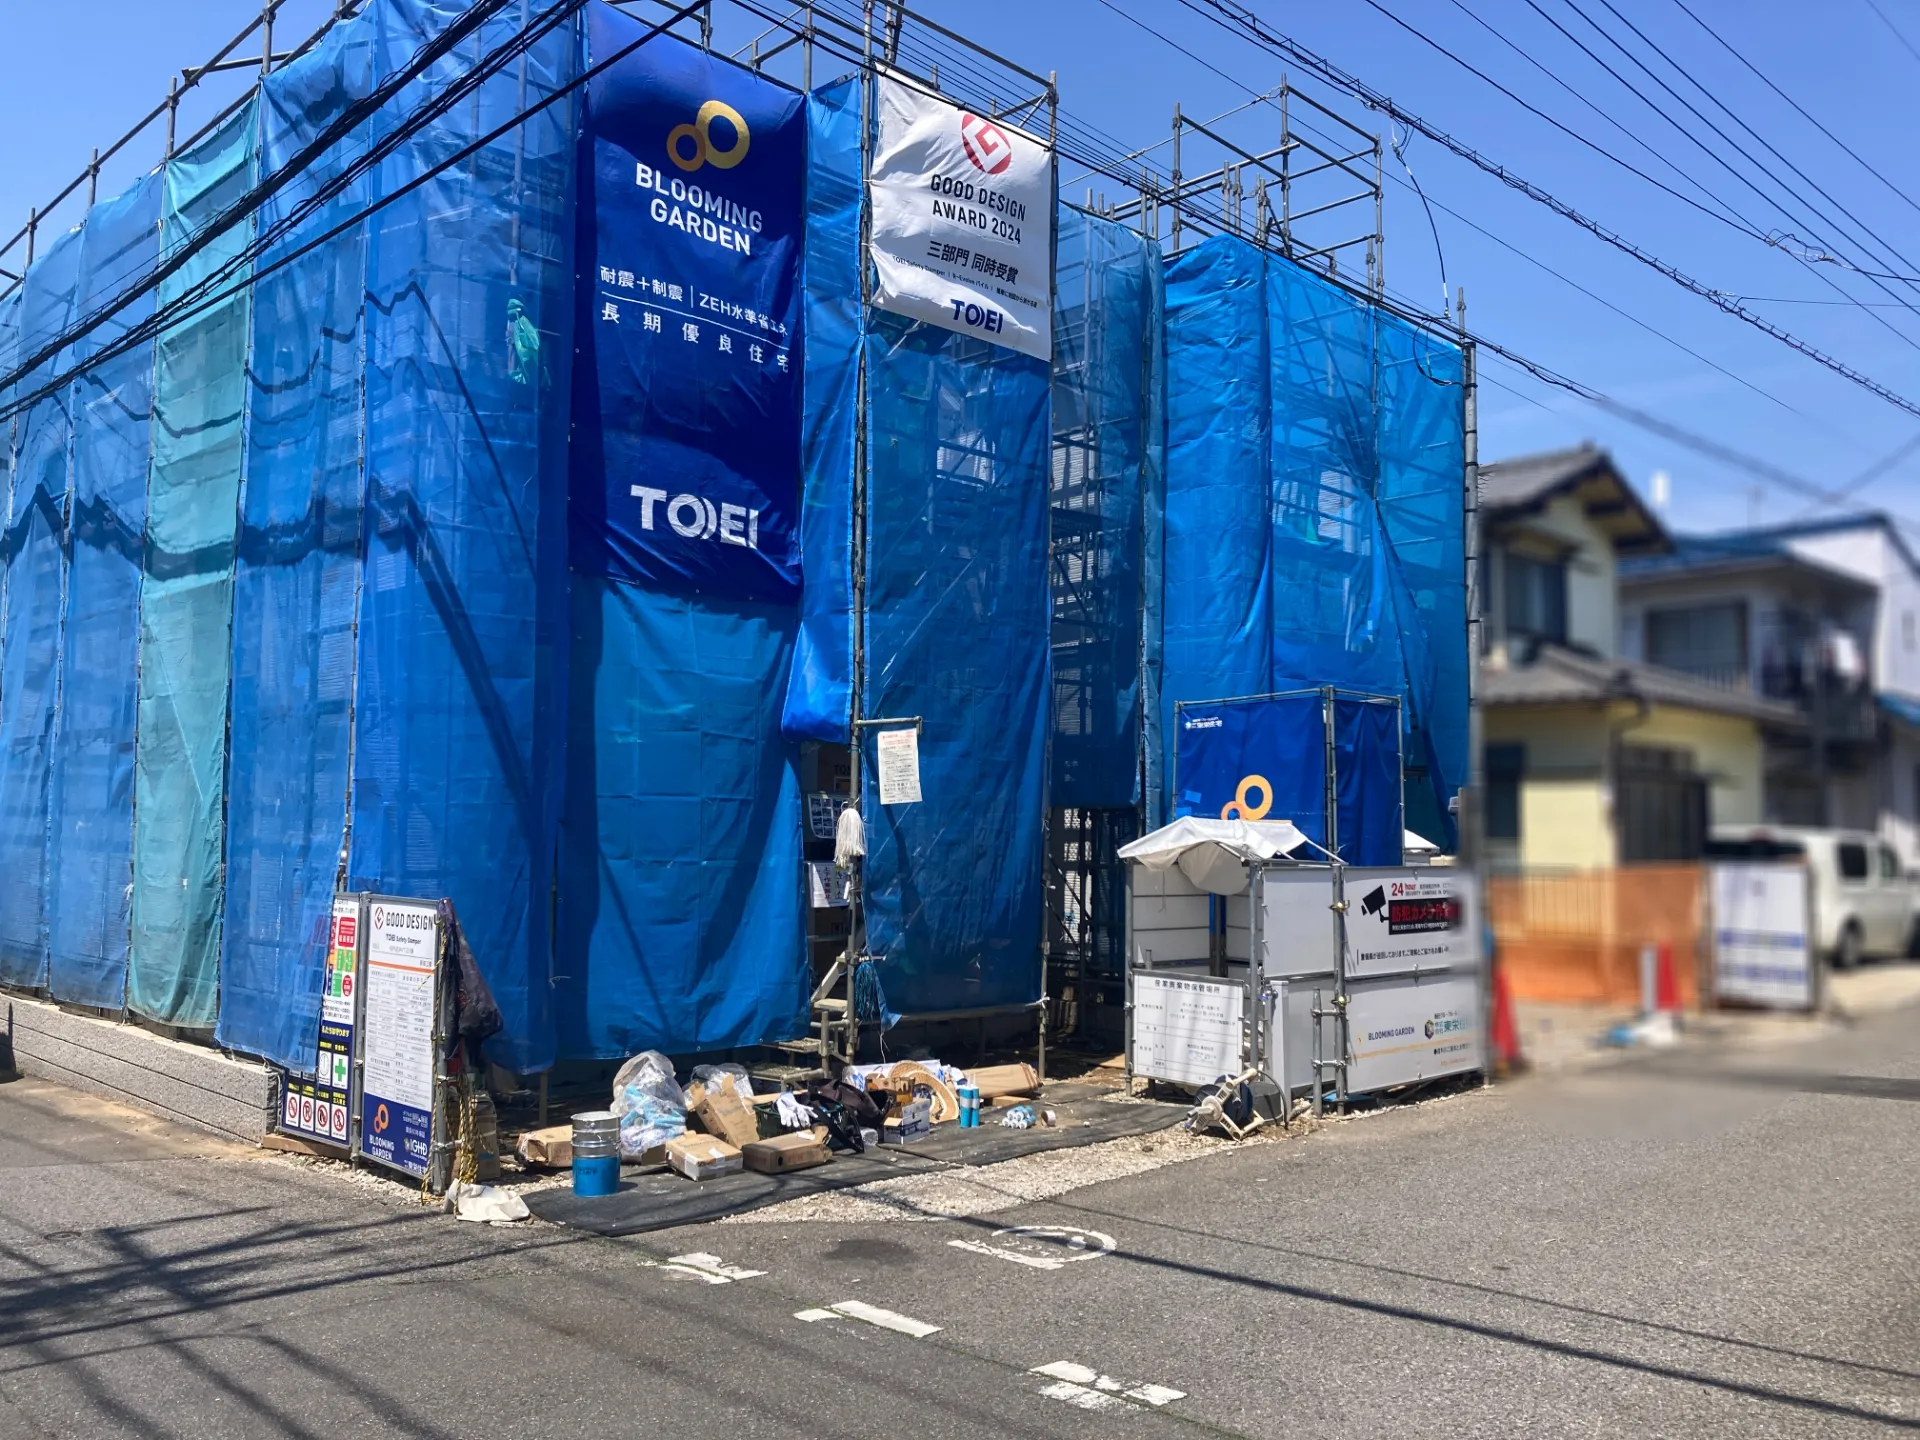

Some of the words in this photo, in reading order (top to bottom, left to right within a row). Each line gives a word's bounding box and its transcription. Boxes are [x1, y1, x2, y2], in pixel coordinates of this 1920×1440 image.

[635, 162, 763, 233] BLOOMING
[930, 173, 974, 200] GOOD
[978, 188, 1026, 222] DESIGN
[650, 198, 751, 256] GARDEN
[932, 199, 988, 231] AWARD
[991, 217, 1022, 245] 2024
[927, 240, 970, 267] 三部門
[971, 252, 1019, 286] 同時受賞
[699, 292, 789, 337] ZEH水準省エネ
[950, 298, 1004, 334] TOEI
[630, 484, 760, 550] TOEI
[1391, 883, 1404, 897] 24
[1405, 883, 1416, 891] hour
[386, 911, 405, 928] GOOD
[406, 913, 434, 931] DESIGN
[1368, 1029, 1395, 1041] BLOOMING
[1394, 1026, 1415, 1037] GARDEN
[369, 1134, 395, 1152] BLOOMING
[371, 1146, 393, 1162] GARDEN
